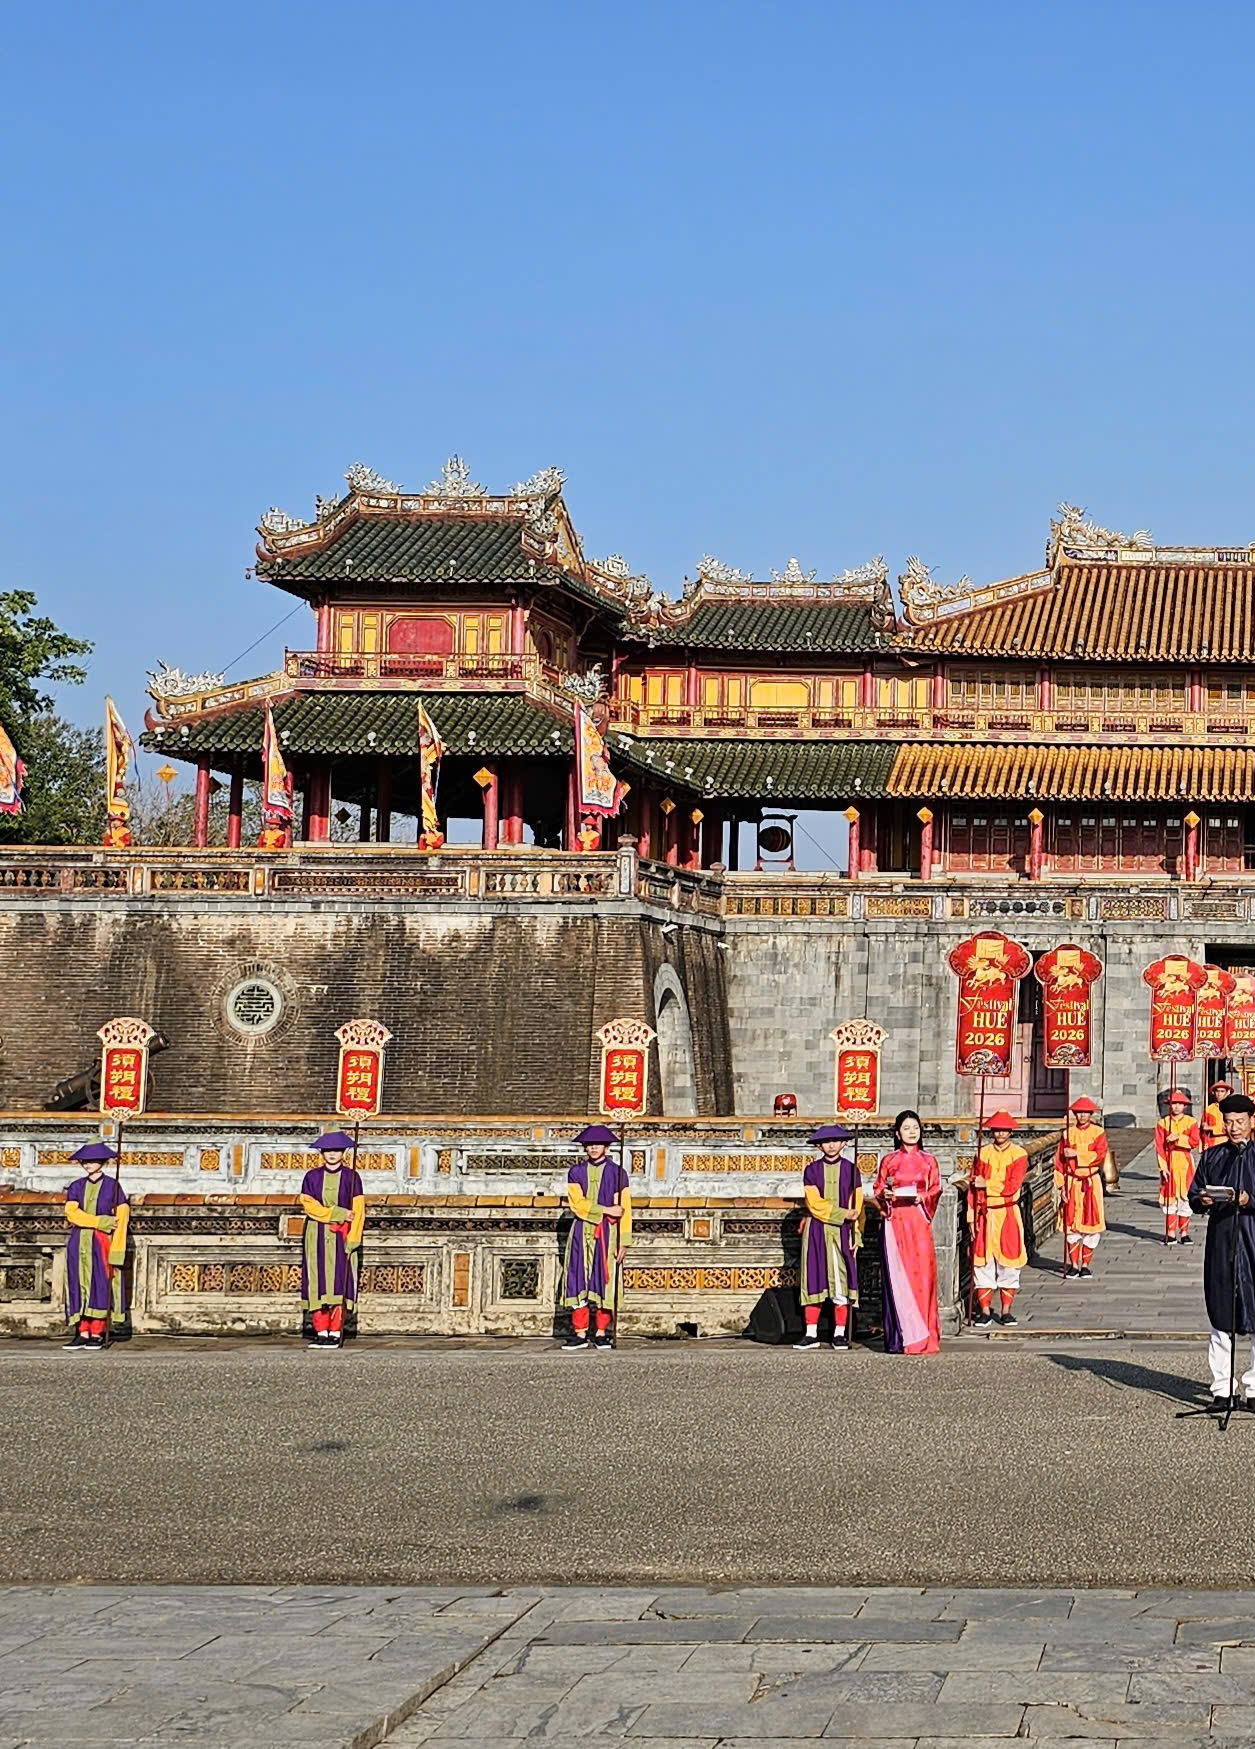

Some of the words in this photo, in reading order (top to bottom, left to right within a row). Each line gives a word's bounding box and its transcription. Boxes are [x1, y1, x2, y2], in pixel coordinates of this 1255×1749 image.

[960, 989, 1013, 1016] Festival
[964, 1031, 1005, 1046] 2026
[1050, 1029, 1085, 1041] 2026
[1156, 1028, 1189, 1040] 2026
[1199, 1029, 1221, 1039] 026
[1231, 1030, 1255, 1039] 2026
